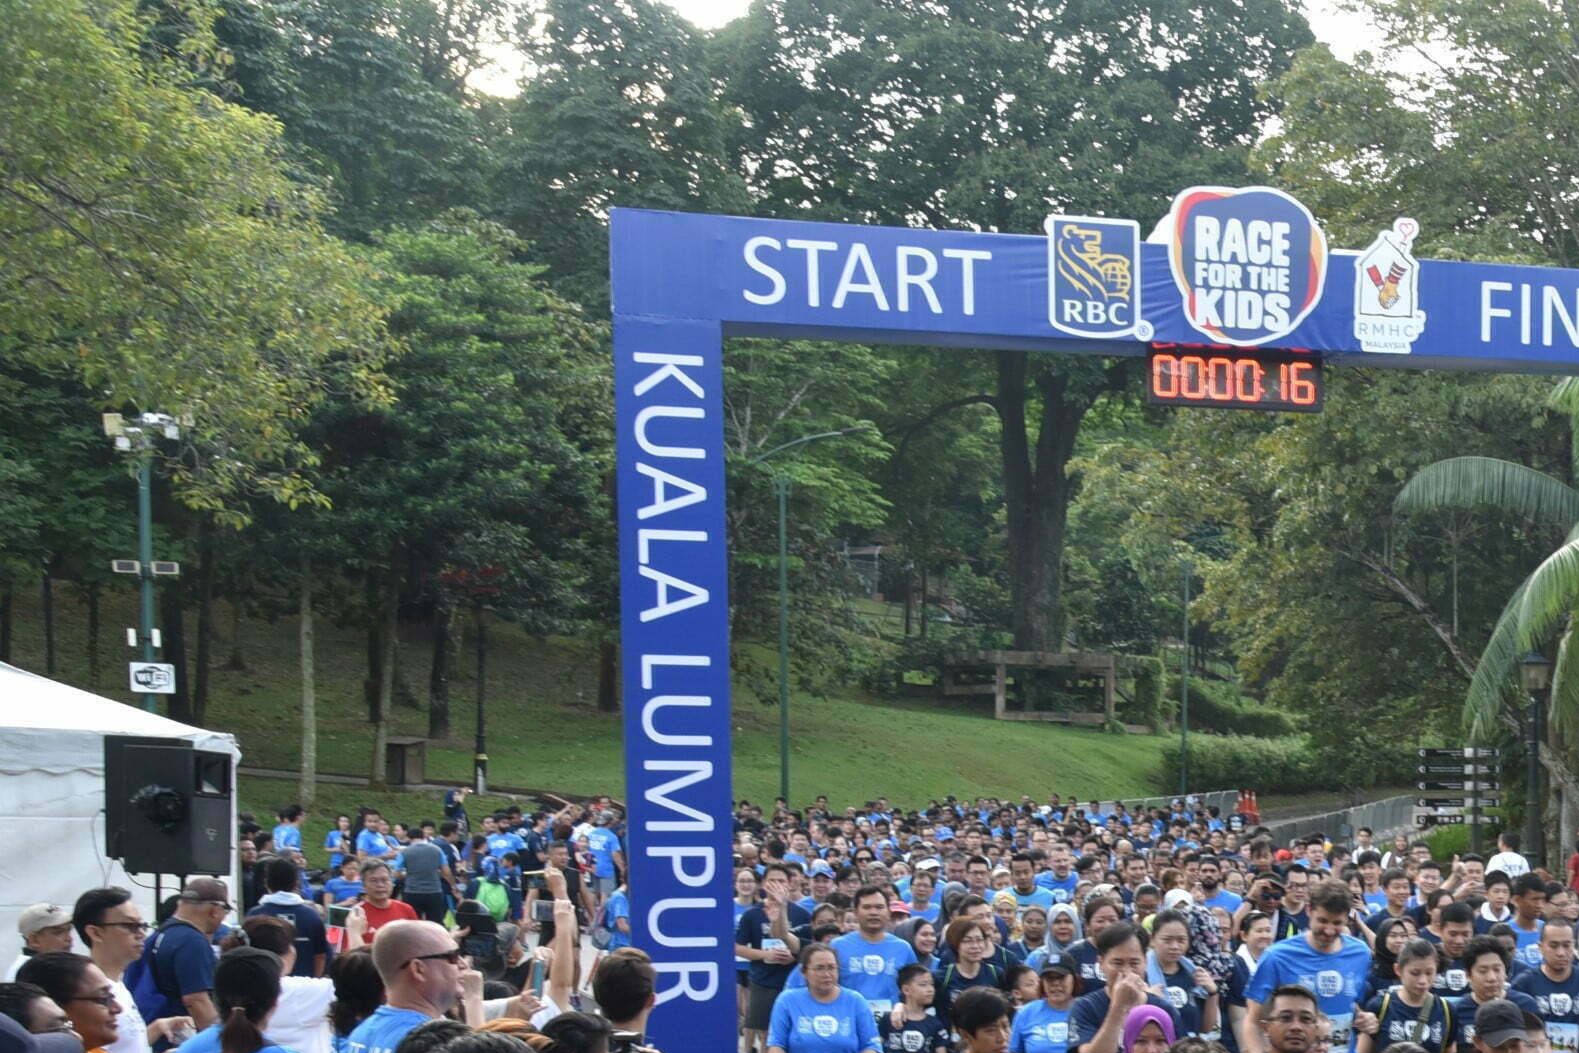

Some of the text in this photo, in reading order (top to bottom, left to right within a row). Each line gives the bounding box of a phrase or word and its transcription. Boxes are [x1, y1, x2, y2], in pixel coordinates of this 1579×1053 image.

[1194, 215, 1291, 267] RACE
[742, 236, 993, 316] START
[1197, 262, 1291, 293] FOR THE
[1062, 299, 1129, 327] RBC
[1198, 286, 1291, 332] KIDS
[1358, 321, 1414, 338] RMHC
[1365, 340, 1407, 350] MALAYSIA
[632, 354, 720, 1008] KUALA LUMPUR
